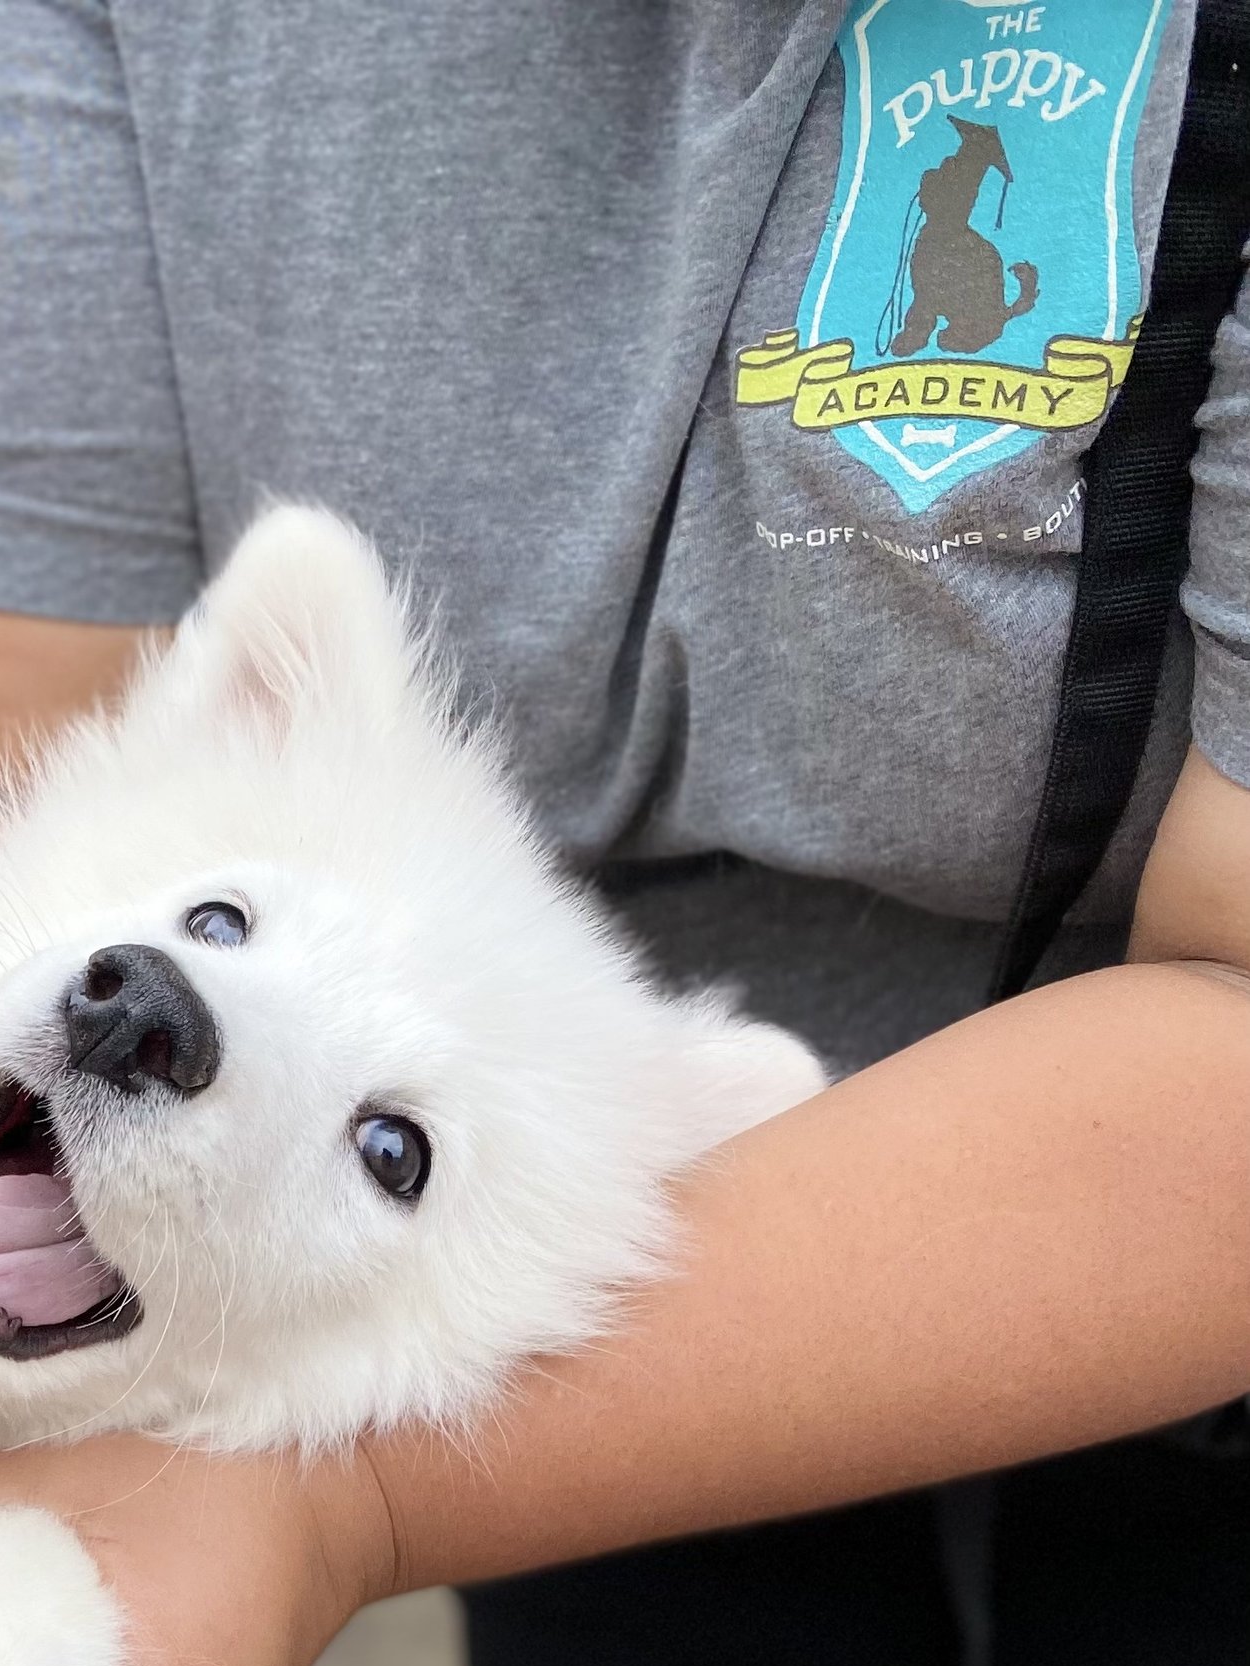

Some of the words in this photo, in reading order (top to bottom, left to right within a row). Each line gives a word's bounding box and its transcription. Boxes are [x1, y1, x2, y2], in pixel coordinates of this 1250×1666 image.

[986, 6, 1046, 41] THE
[882, 48, 1107, 149] puppy
[817, 376, 1074, 417] ACADEMY
[872, 531, 983, 563] TRAINING
